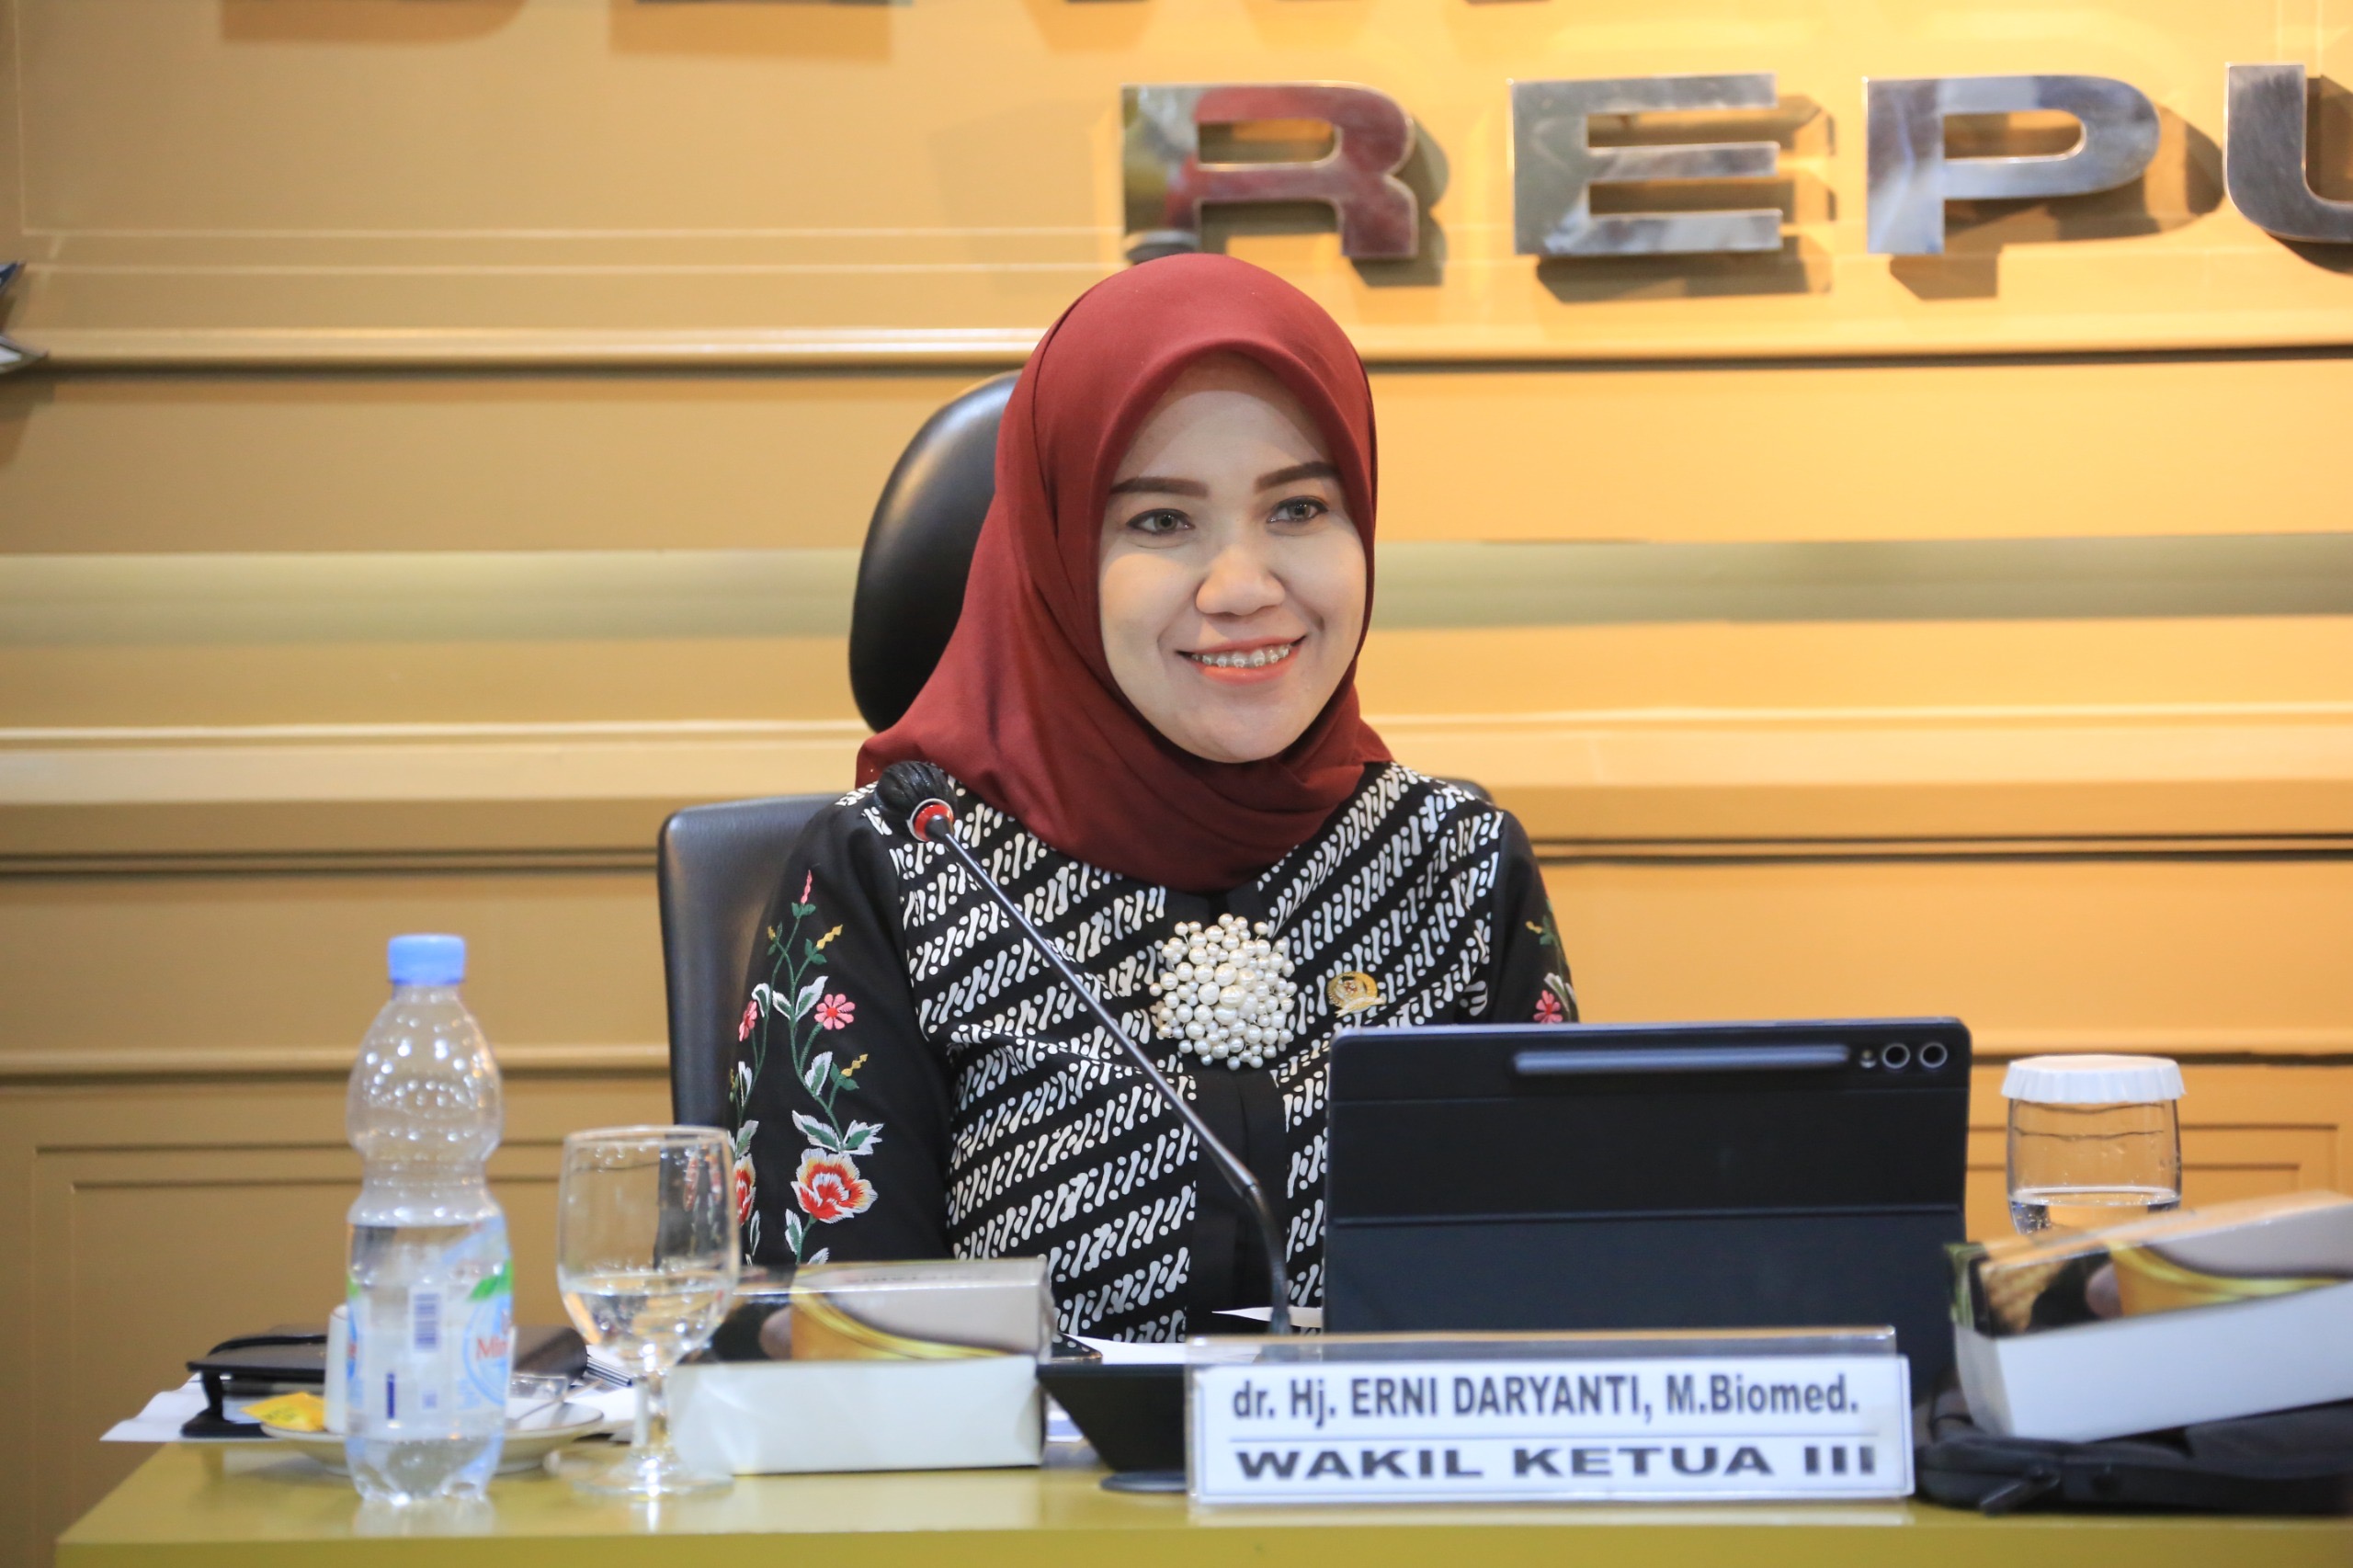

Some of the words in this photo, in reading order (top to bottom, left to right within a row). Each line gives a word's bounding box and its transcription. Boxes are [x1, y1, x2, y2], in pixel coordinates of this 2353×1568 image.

[1233, 1380, 1275, 1418] dr.
[1290, 1379, 1336, 1429] Hj.
[1351, 1378, 1438, 1417] ERNI
[1454, 1374, 1653, 1424] DARYANTI,
[1666, 1373, 1859, 1415] M.Biomed.
[1236, 1449, 1483, 1480] WAKIL
[1514, 1446, 1775, 1478] KETUA
[1803, 1445, 1876, 1476] III
